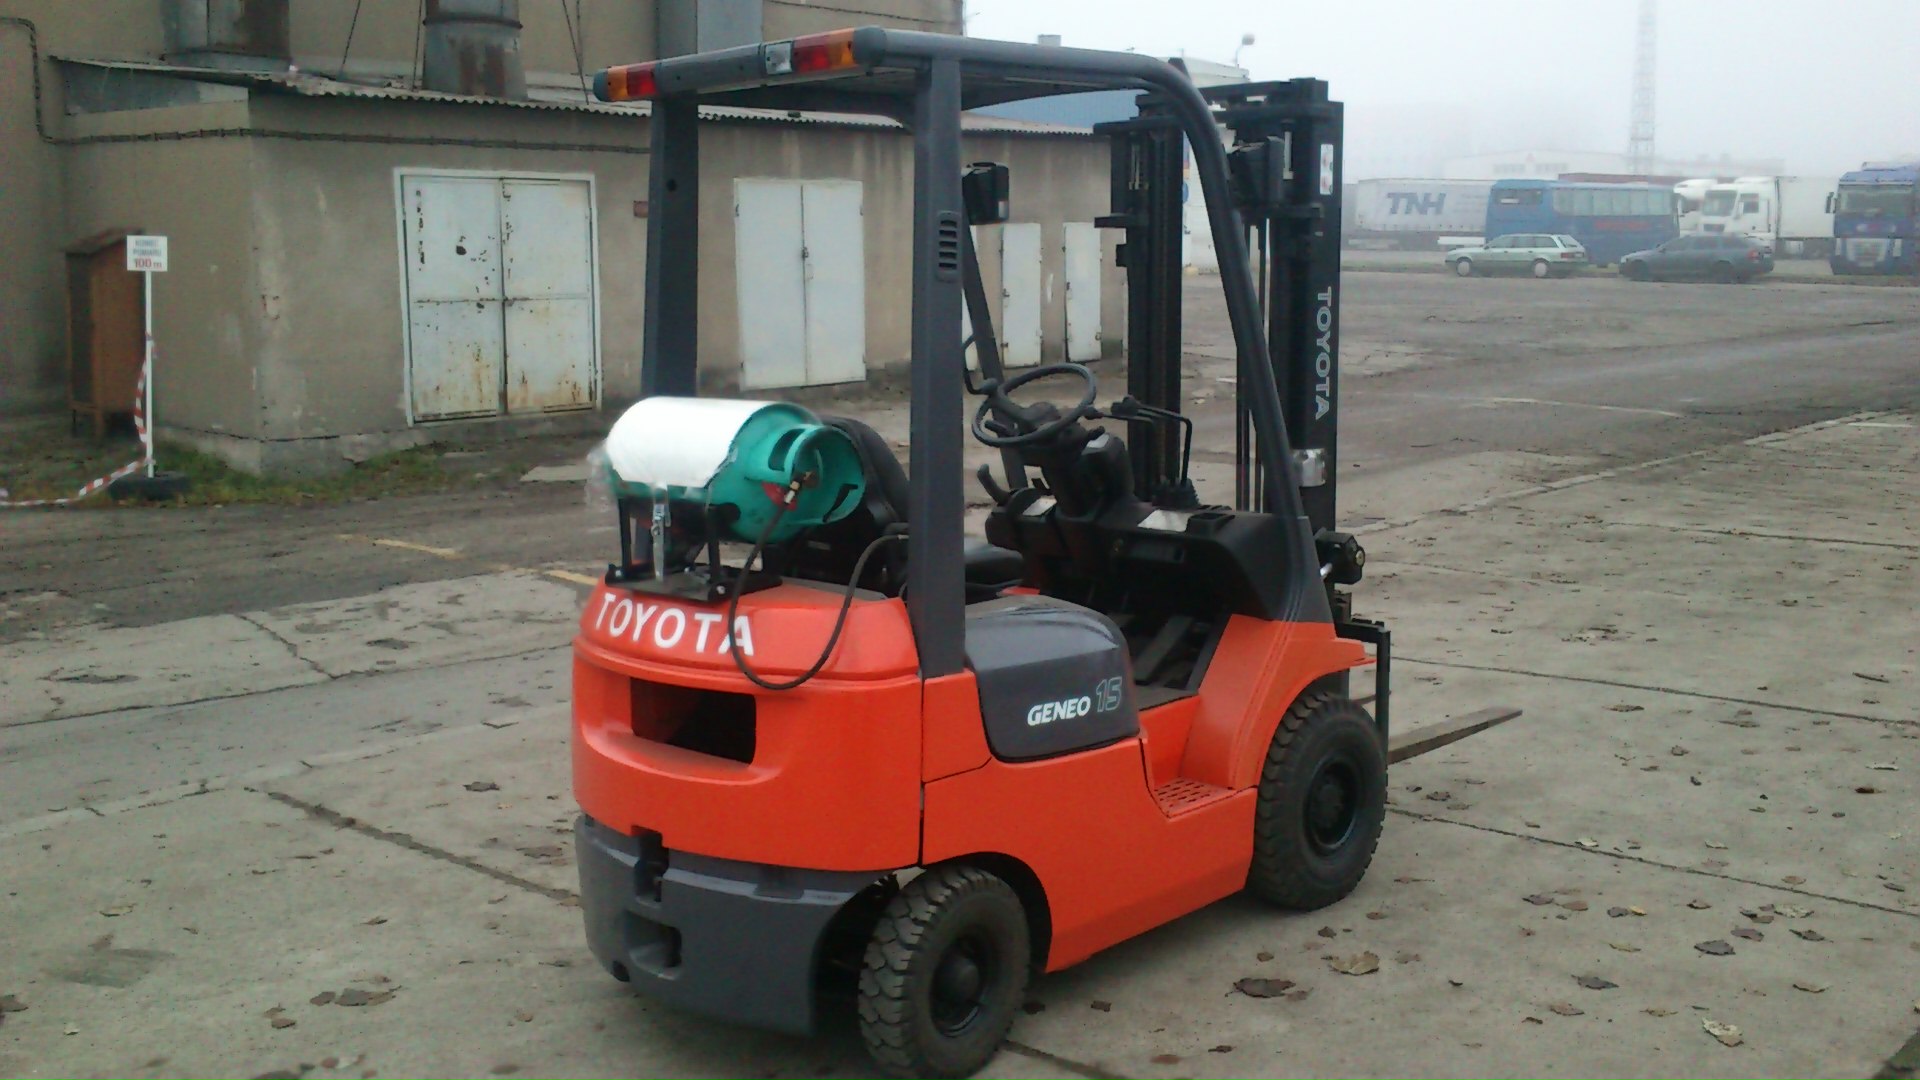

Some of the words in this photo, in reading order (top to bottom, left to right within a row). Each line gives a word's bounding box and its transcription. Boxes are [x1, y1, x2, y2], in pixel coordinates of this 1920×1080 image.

[1386, 192, 1447, 215] TNH
[134, 258, 152, 268] 100
[1315, 286, 1332, 420] TOYOTA
[595, 592, 755, 656] TOYOTA
[1027, 695, 1091, 726] GENEO
[1096, 676, 1122, 712] 15
